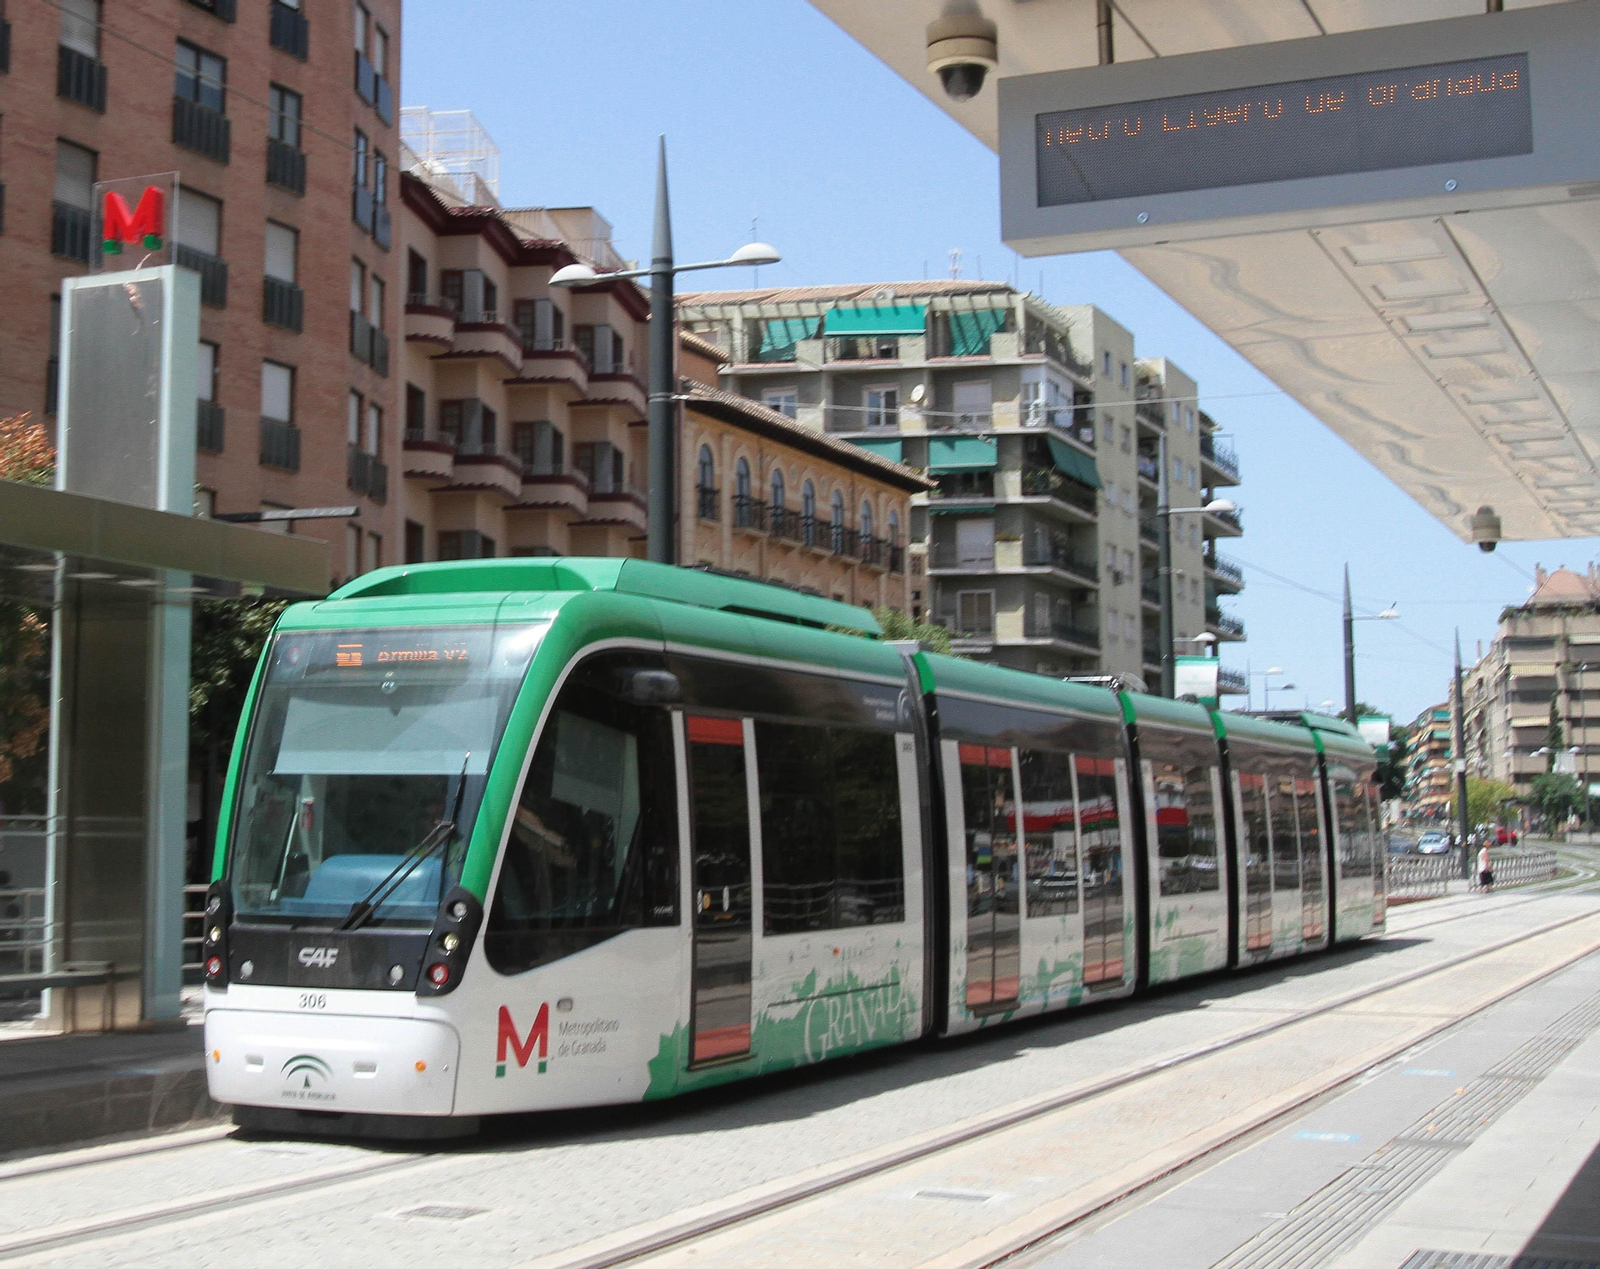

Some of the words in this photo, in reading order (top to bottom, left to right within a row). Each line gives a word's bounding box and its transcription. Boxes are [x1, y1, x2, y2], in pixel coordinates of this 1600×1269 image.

[102, 184, 164, 254] M
[298, 946, 340, 969] CAF
[298, 992, 327, 1009] 306
[495, 1001, 549, 1078] M
